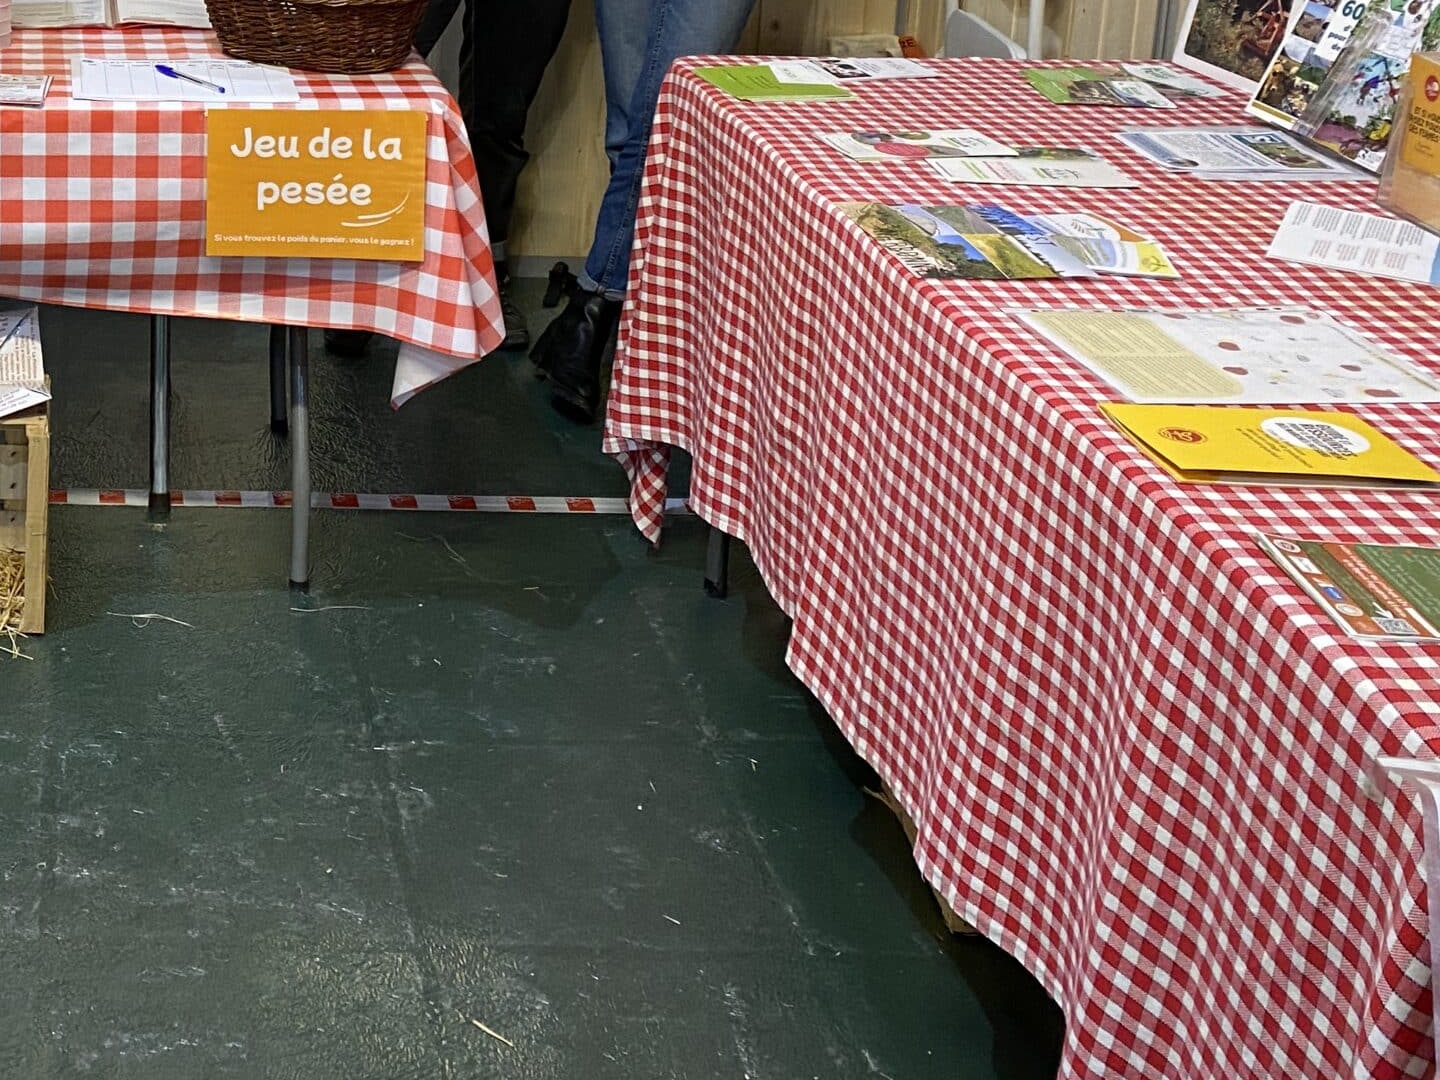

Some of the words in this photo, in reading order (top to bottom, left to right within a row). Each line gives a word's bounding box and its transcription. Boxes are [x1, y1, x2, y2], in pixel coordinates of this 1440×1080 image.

[1342, 0, 1366, 21] 60
[229, 126, 301, 159] Jeu
[308, 126, 354, 160] de
[362, 127, 403, 162] la
[256, 172, 373, 211] pesée
[214, 233, 222, 242] Si
[222, 234, 243, 243] vous
[243, 233, 277, 243] trouvez
[277, 234, 286, 243] le
[286, 234, 309, 245] poids
[348, 236, 369, 246] vous
[369, 236, 380, 246] le
